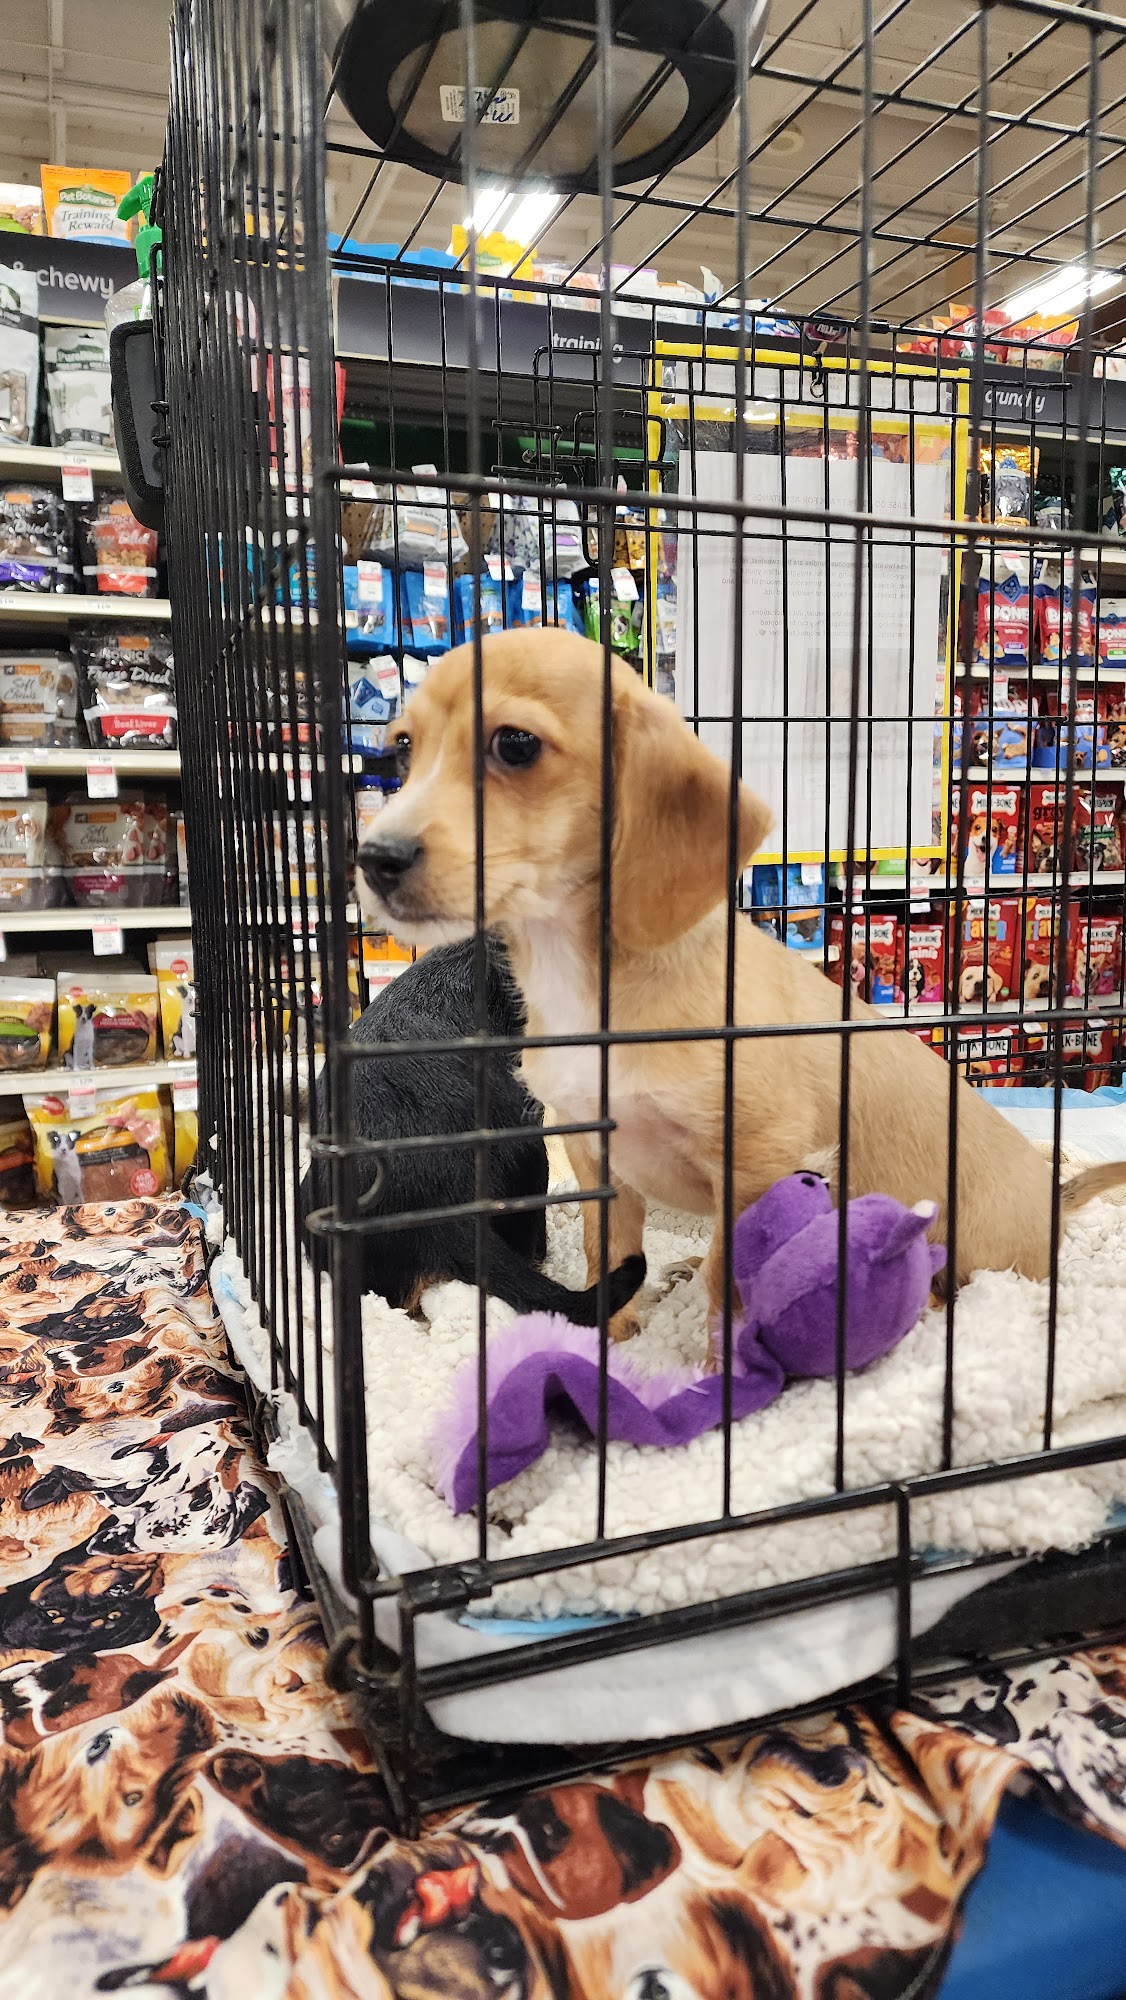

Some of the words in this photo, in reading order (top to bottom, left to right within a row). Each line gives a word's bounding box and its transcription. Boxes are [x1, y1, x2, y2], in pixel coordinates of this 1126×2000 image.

[59, 191, 76, 202] Pet
[61, 208, 111, 223] Training
[68, 219, 114, 232] Reward
[36, 265, 115, 300] chewy
[553, 332, 624, 364] trainig
[986, 604, 1032, 622] BONE
[129, 666, 171, 686] Dried
[976, 797, 1013, 809] MIL-BONE
[854, 928, 890, 939] MIL-BONE
[1048, 1033, 1098, 1051] MLK-BNE
